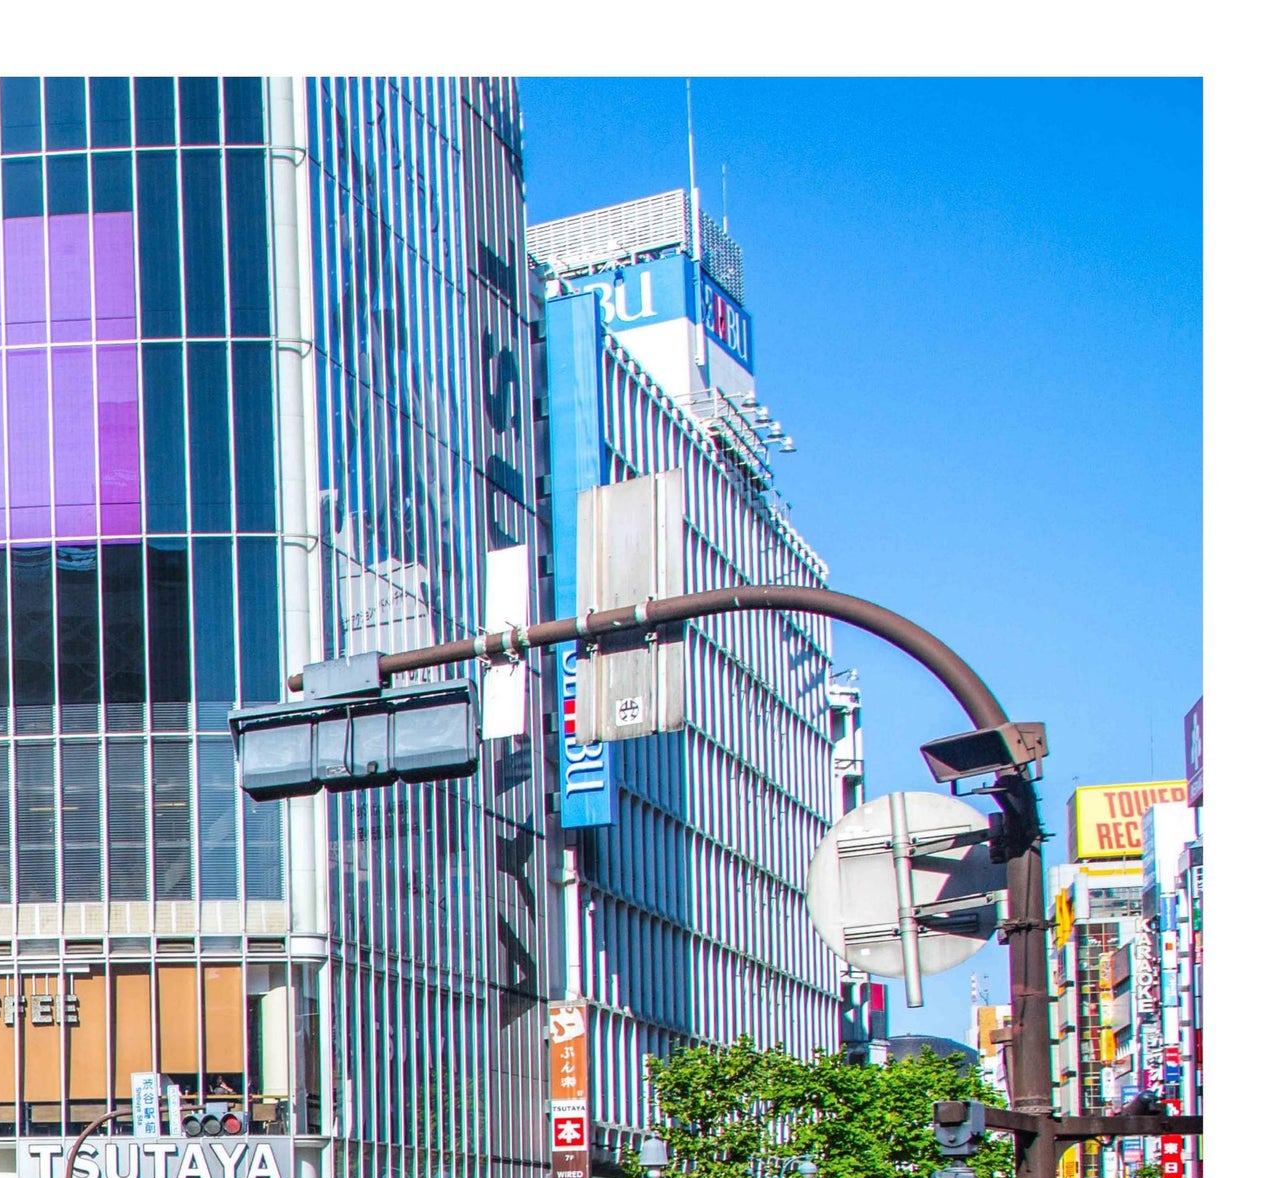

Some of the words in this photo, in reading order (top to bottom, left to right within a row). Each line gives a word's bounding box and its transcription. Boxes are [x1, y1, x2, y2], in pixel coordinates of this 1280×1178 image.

[1136, 917, 1152, 1012] KARAOKE
[143, 1078, 156, 1134] 渋谷駅前
[556, 1120, 582, 1145] 本
